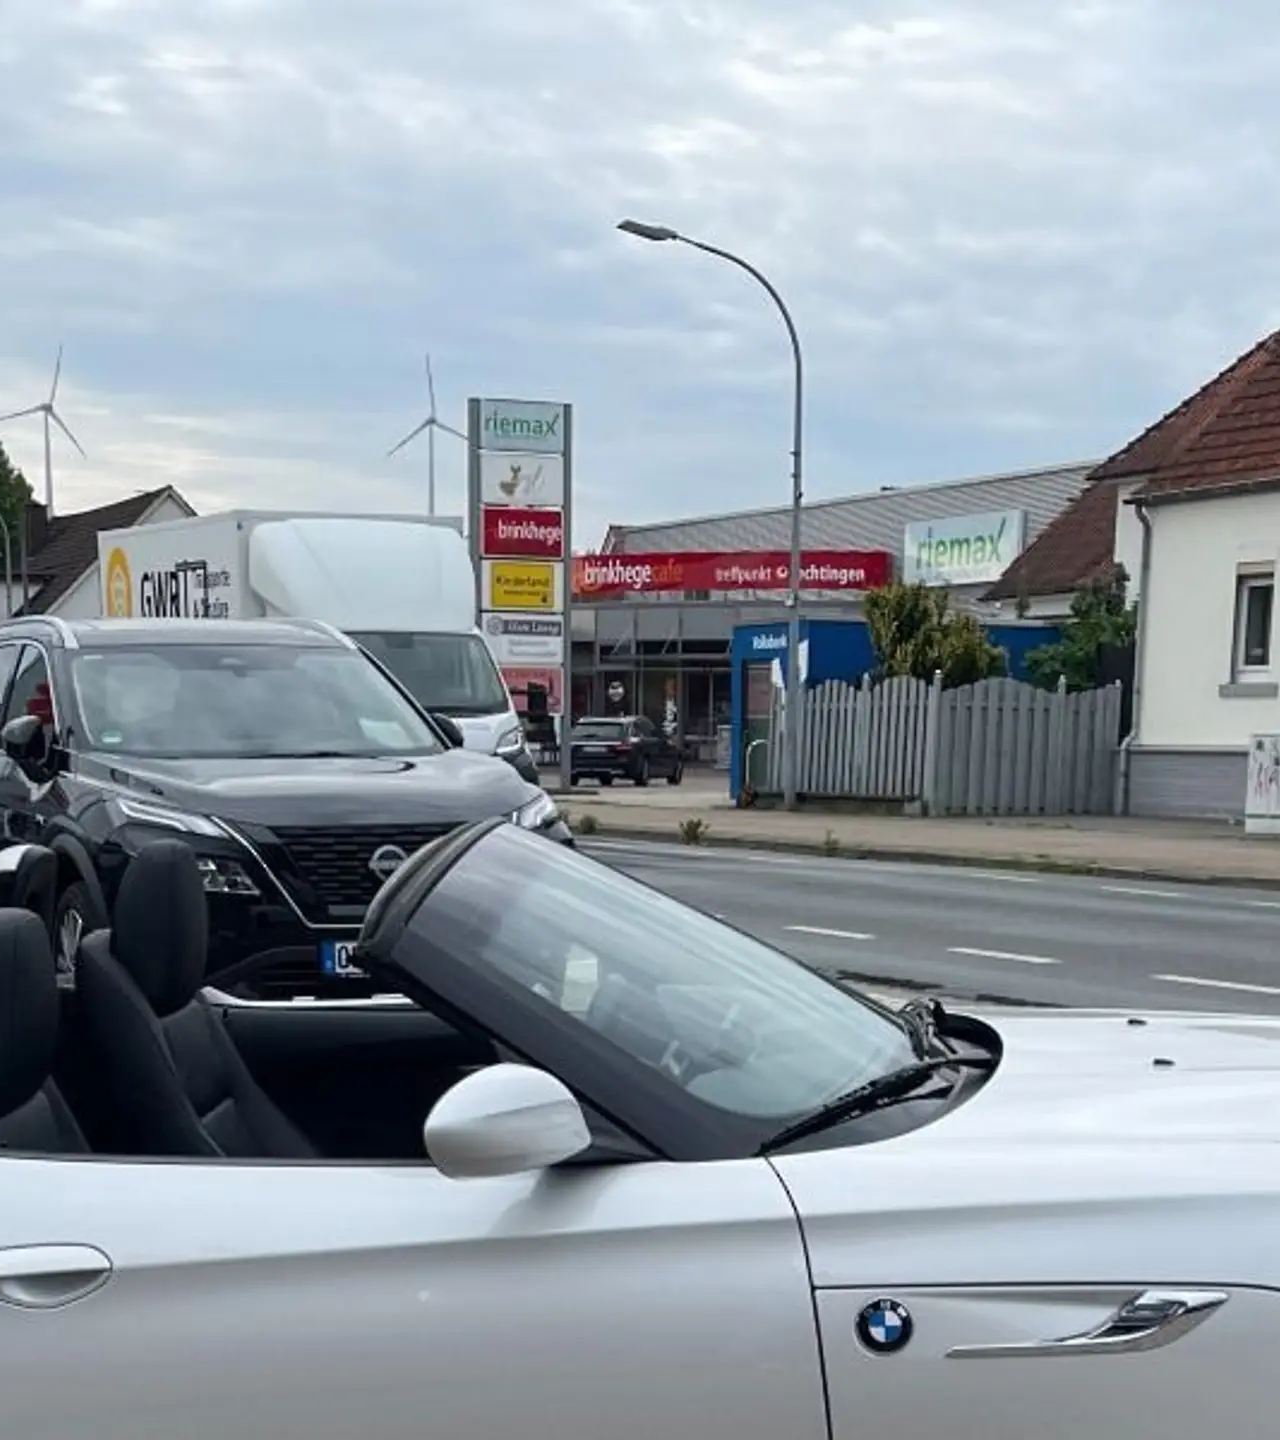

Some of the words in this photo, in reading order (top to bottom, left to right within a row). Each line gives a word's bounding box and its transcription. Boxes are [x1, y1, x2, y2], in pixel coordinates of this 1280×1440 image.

[484, 408, 560, 438] riemax
[497, 518, 562, 546] brinkhege
[916, 517, 1007, 571] riemax
